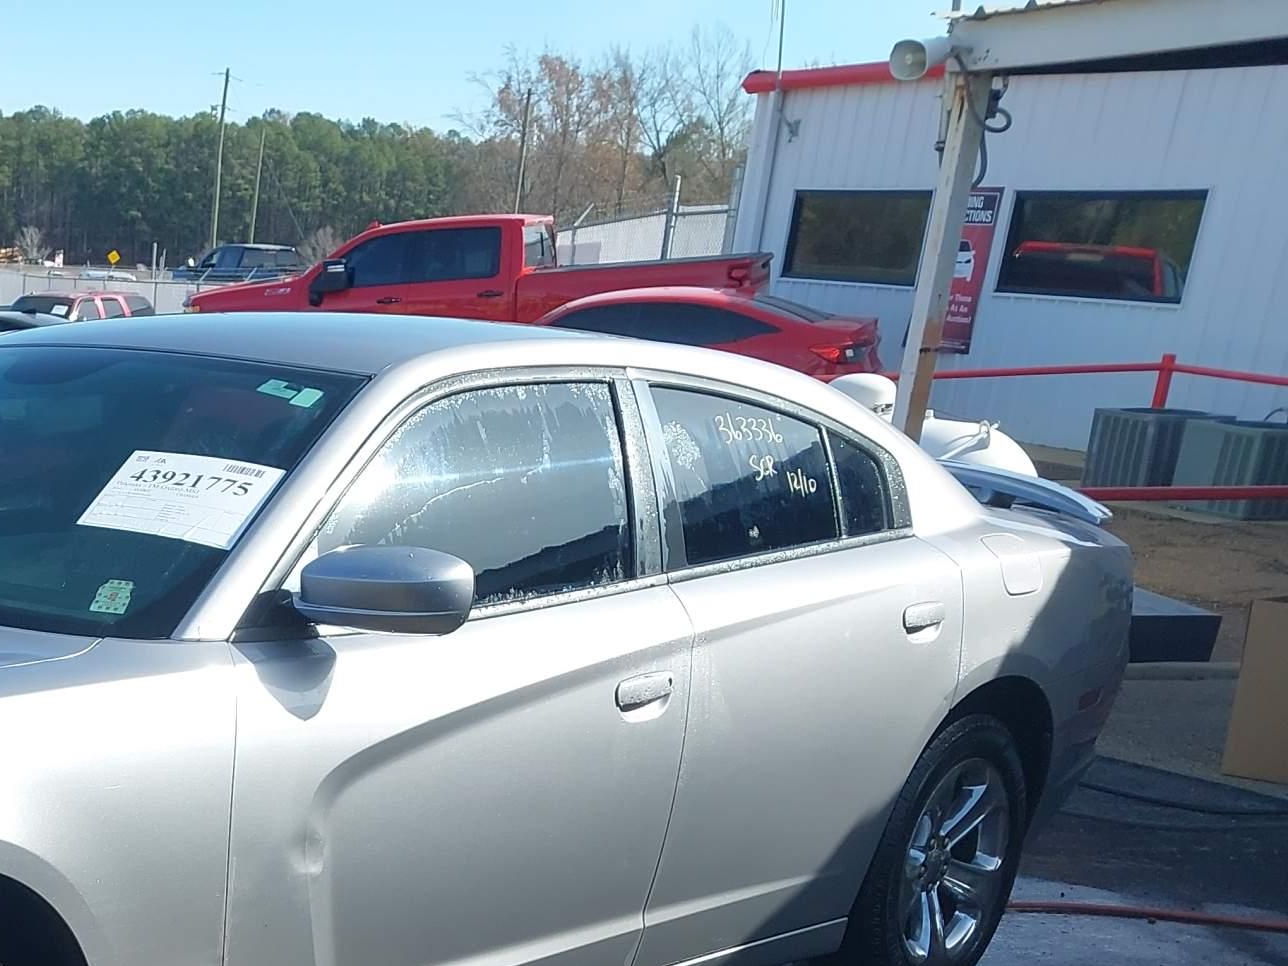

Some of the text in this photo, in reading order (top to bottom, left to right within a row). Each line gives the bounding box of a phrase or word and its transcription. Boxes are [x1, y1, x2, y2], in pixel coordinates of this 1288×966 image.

[715, 412, 783, 444] 363336
[130, 468, 254, 497] 43921775
[786, 468, 817, 498] 12/10
